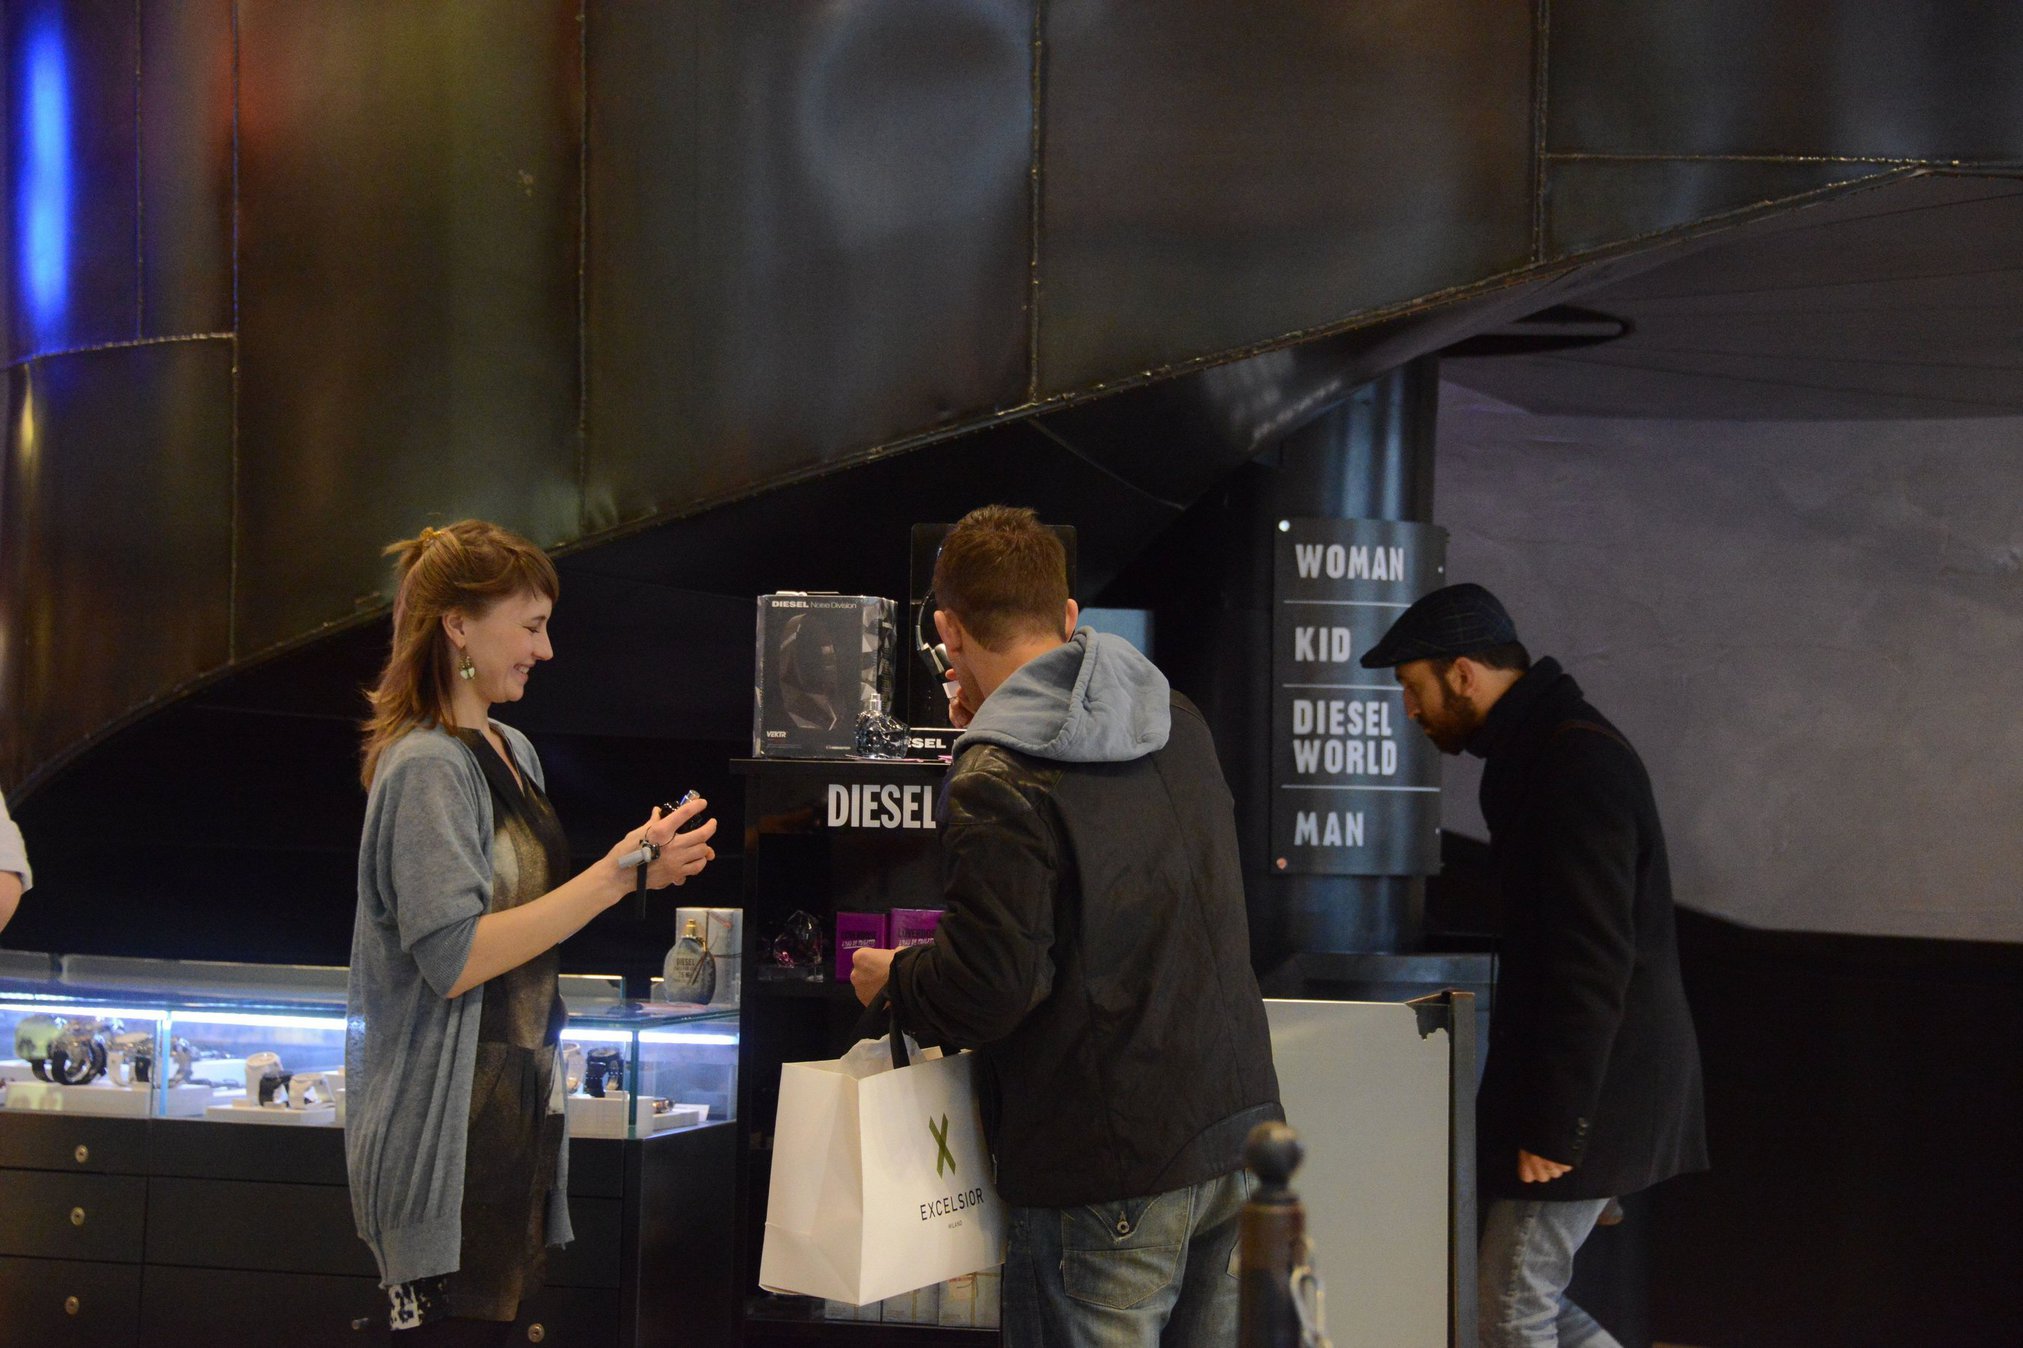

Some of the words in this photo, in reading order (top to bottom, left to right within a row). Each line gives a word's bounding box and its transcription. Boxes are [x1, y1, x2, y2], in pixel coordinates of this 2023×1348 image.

[1294, 544, 1404, 581] WOMAN
[1294, 626, 1350, 663] KID
[1293, 699, 1393, 737] DIESEL
[907, 737, 947, 749] SEL
[1293, 739, 1398, 776] WORLD
[827, 783, 937, 829] DIESEL
[1294, 811, 1364, 847] MAN
[920, 1187, 984, 1221] EXCELSIOR
